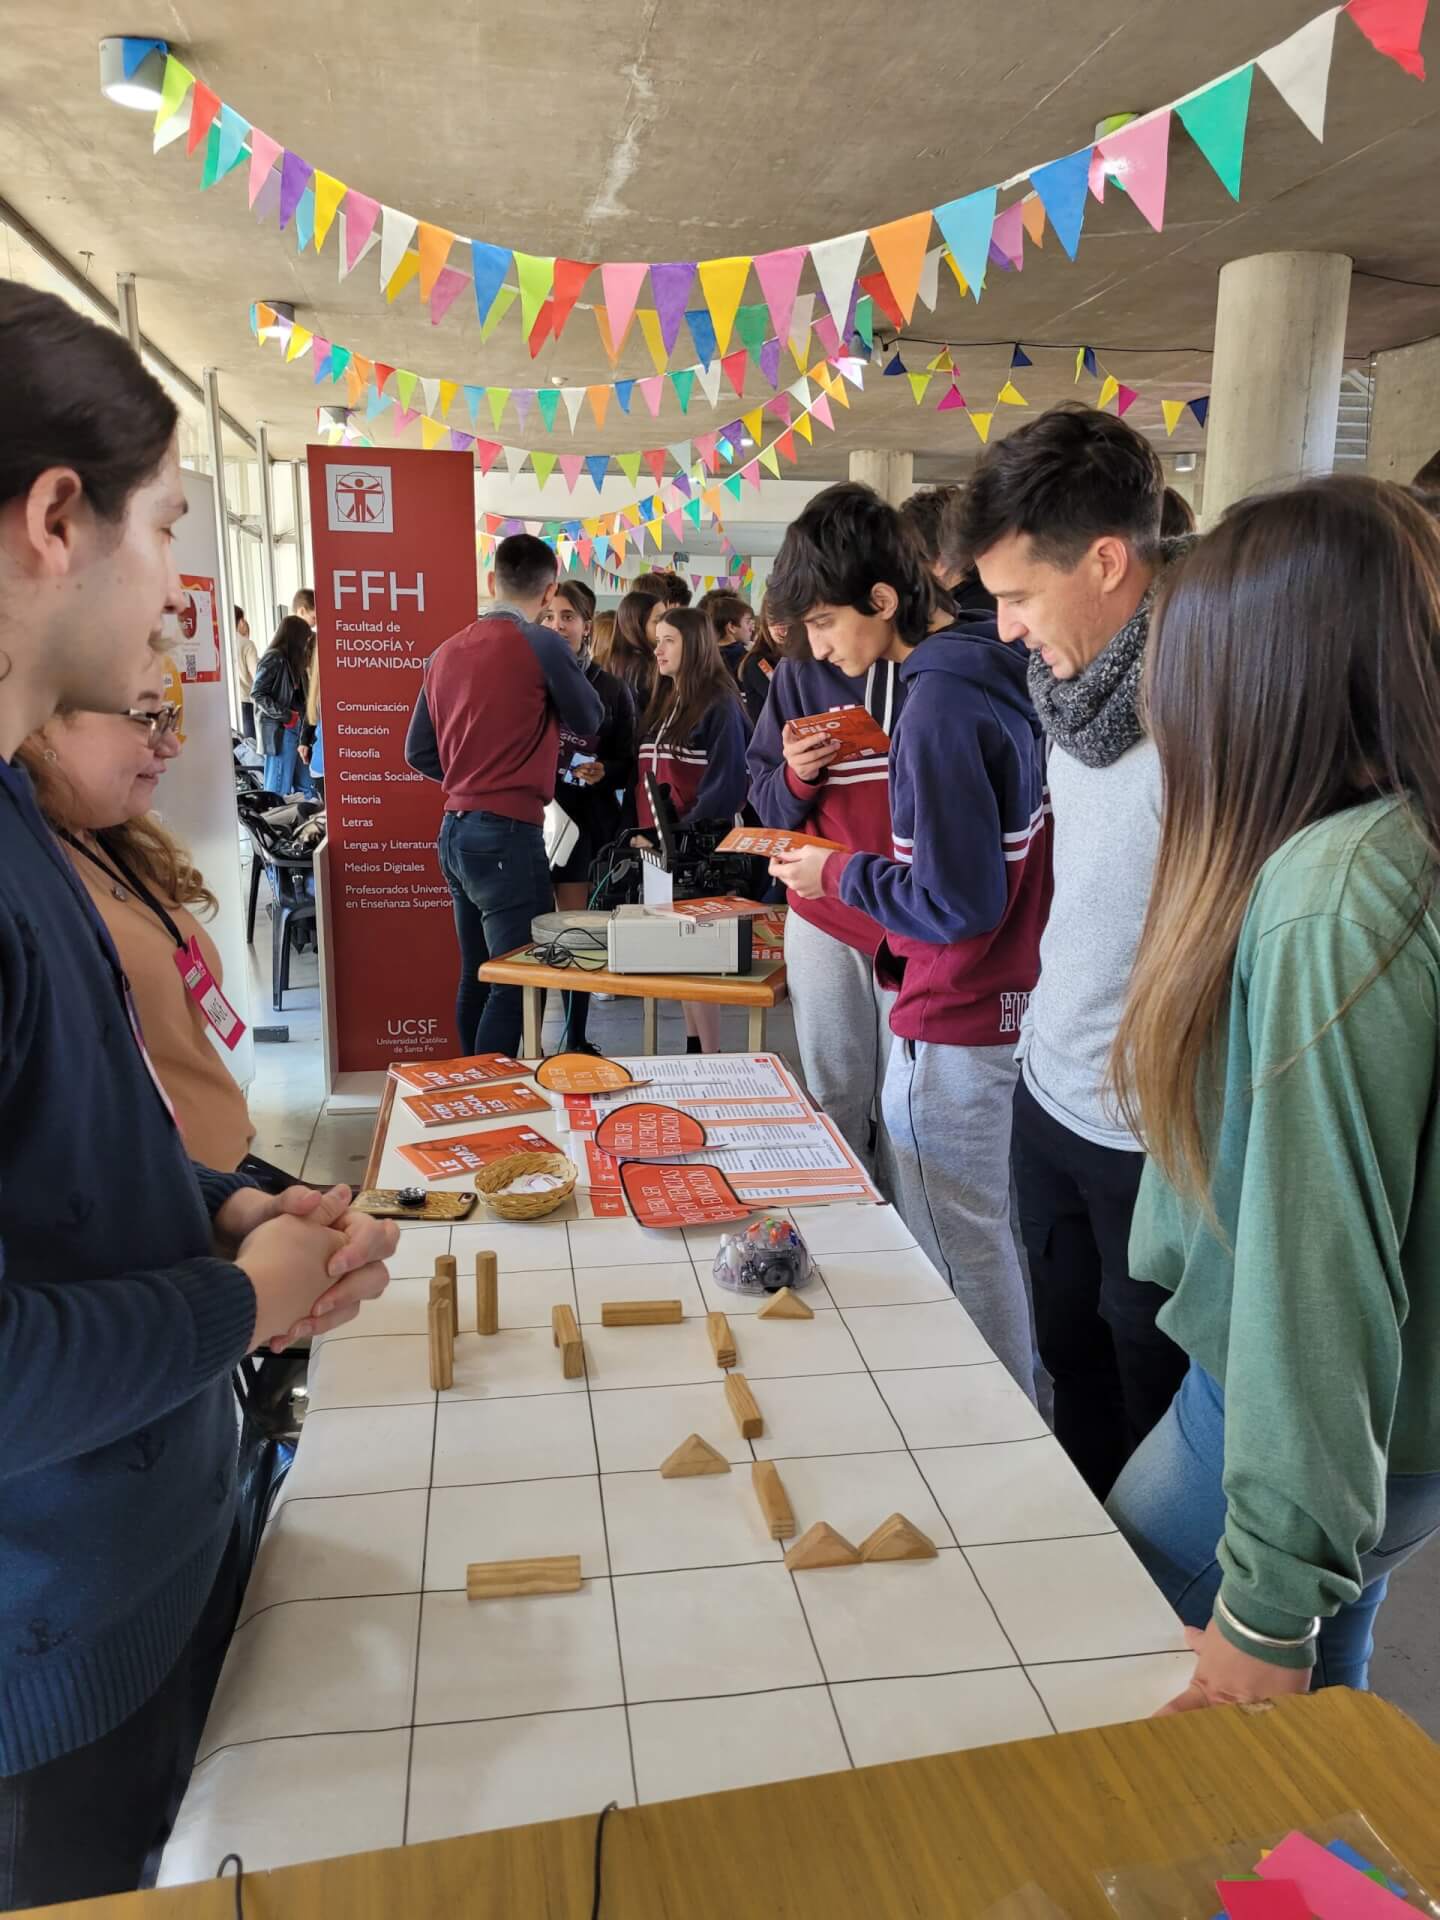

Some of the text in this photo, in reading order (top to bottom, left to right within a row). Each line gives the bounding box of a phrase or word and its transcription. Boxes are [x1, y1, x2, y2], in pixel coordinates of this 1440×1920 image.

[332, 570, 425, 612] FFH
[335, 619, 401, 632] Facultad de
[335, 637, 416, 652] FILOSOFÍA Y
[336, 701, 410, 712] Comunicación
[337, 724, 390, 736] Educación
[338, 748, 381, 760] Filosofía
[339, 771, 424, 781] Ciencias Sociales
[341, 793, 382, 805] Historia
[342, 816, 374, 828] Letras
[343, 839, 438, 852] Lengua y Literatura
[344, 861, 425, 874] Medios Digitales
[345, 884, 410, 895] Profesorados
[345, 897, 455, 910] en Enseñanza Superior
[387, 1018, 438, 1036] UCSF
[376, 1037, 418, 1046] Universidad
[404, 1045, 423, 1053] Santa
[438, 1158, 465, 1173] LE
